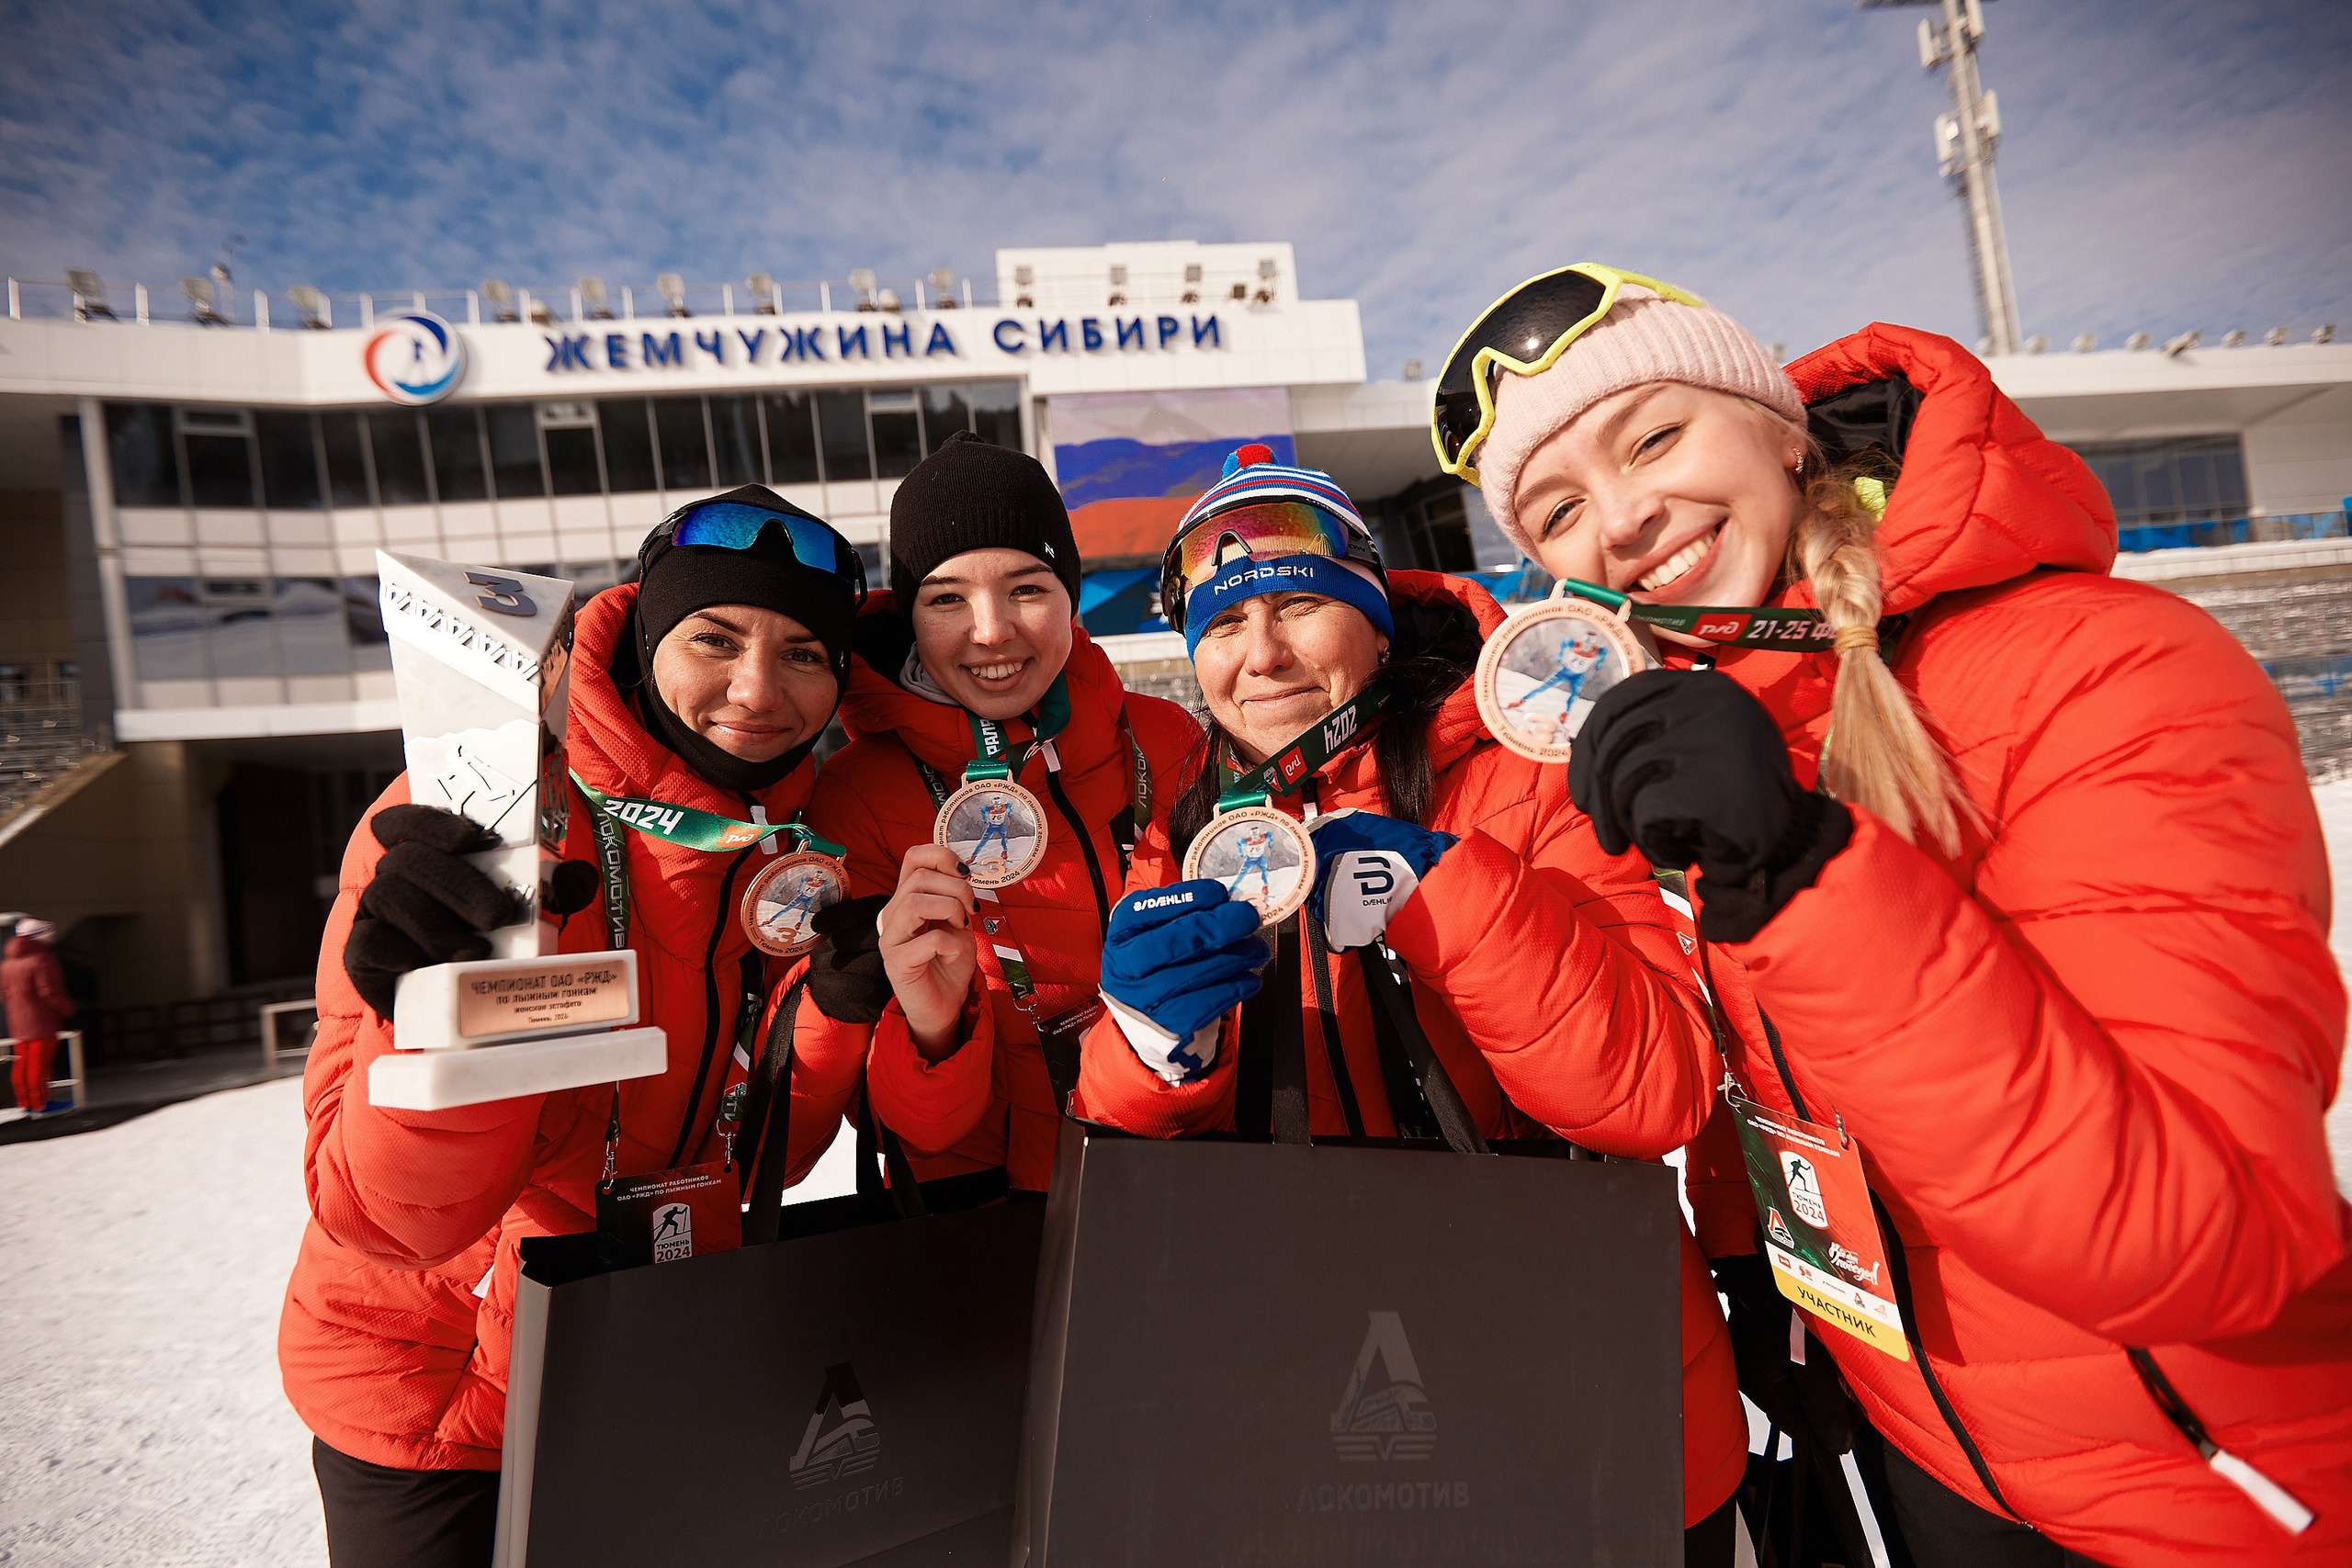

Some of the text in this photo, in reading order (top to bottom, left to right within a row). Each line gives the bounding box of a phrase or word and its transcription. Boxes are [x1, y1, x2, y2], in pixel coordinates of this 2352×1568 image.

[544, 314, 1220, 369] ЖЕМЧУЖИНА СИБИРИ
[1214, 565, 1315, 595] NORDSKI
[463, 571, 537, 616] 3
[1747, 620, 1812, 638] 21-25
[941, 788, 973, 823] работников
[975, 783, 991, 791] ОАО
[994, 783, 1018, 793] «РЖД»
[1019, 792, 1028, 800] по
[1228, 811, 1248, 821] ОАО
[1250, 810, 1278, 820] «РЖД»
[603, 799, 684, 835] 2024
[596, 811, 626, 949] ЛОКОМОТИВ
[967, 870, 1021, 885] Тюмень 2024
[748, 884, 765, 927] Чемпионат
[763, 858, 807, 884] работников
[758, 938, 784, 953] Тюмень
[471, 969, 617, 995] ЧЕМПИОНАТ ОАО «РЖД»
[496, 987, 596, 1005] по лыжным гонкам
[629, 1175, 709, 1192] ЧЕМПИОНАТ РАБОТНИКОВ
[664, 1184, 695, 1193] ЛЫЖНЫМ
[696, 1179, 721, 1189] ГОНКАМ
[1793, 1199, 1826, 1224] 2024
[656, 1246, 691, 1263] 2024
[657, 1239, 690, 1249] ТЮМЕНЬ
[1796, 1285, 1876, 1337] УЧАСТНИК
[758, 1476, 905, 1538] ЛОКОМОТИВ
[1298, 1482, 1471, 1512] ЛОКОМОТИВ
